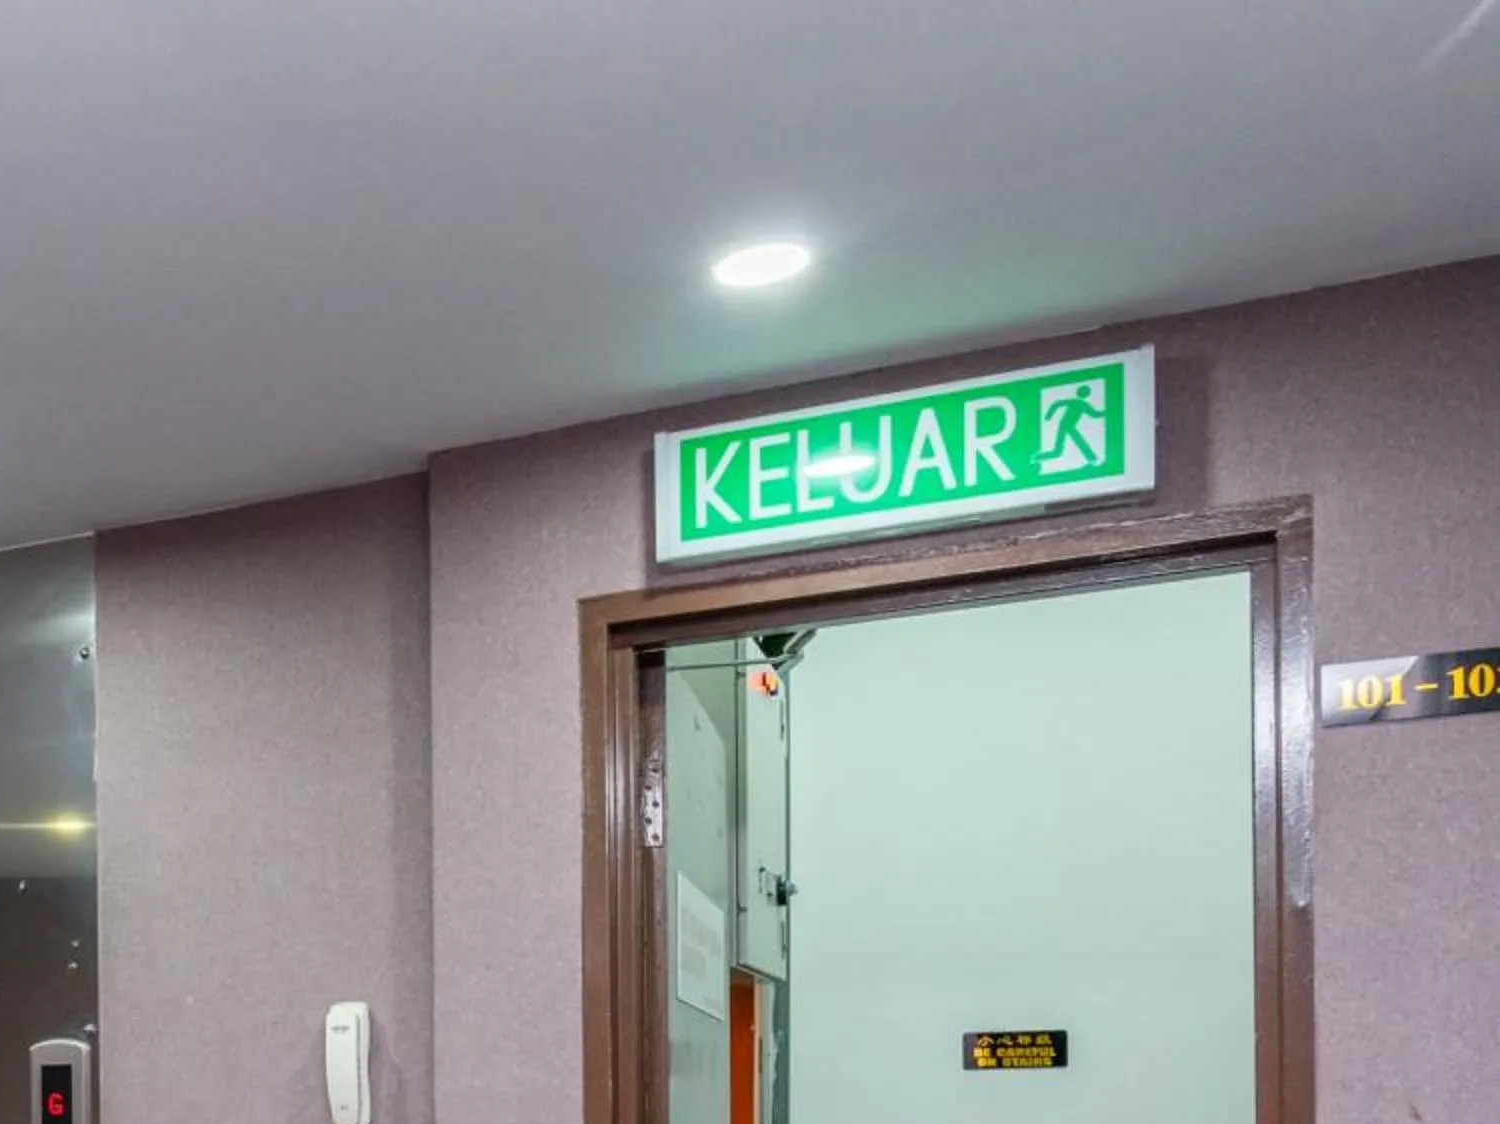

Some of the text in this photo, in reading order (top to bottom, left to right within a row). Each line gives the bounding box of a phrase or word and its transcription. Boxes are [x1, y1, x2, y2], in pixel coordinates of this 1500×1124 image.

[694, 396, 1017, 529] KELUAR
[1338, 674, 1407, 710] 101
[1446, 663, 1500, 700] 10
[47, 1093, 65, 1116] G
